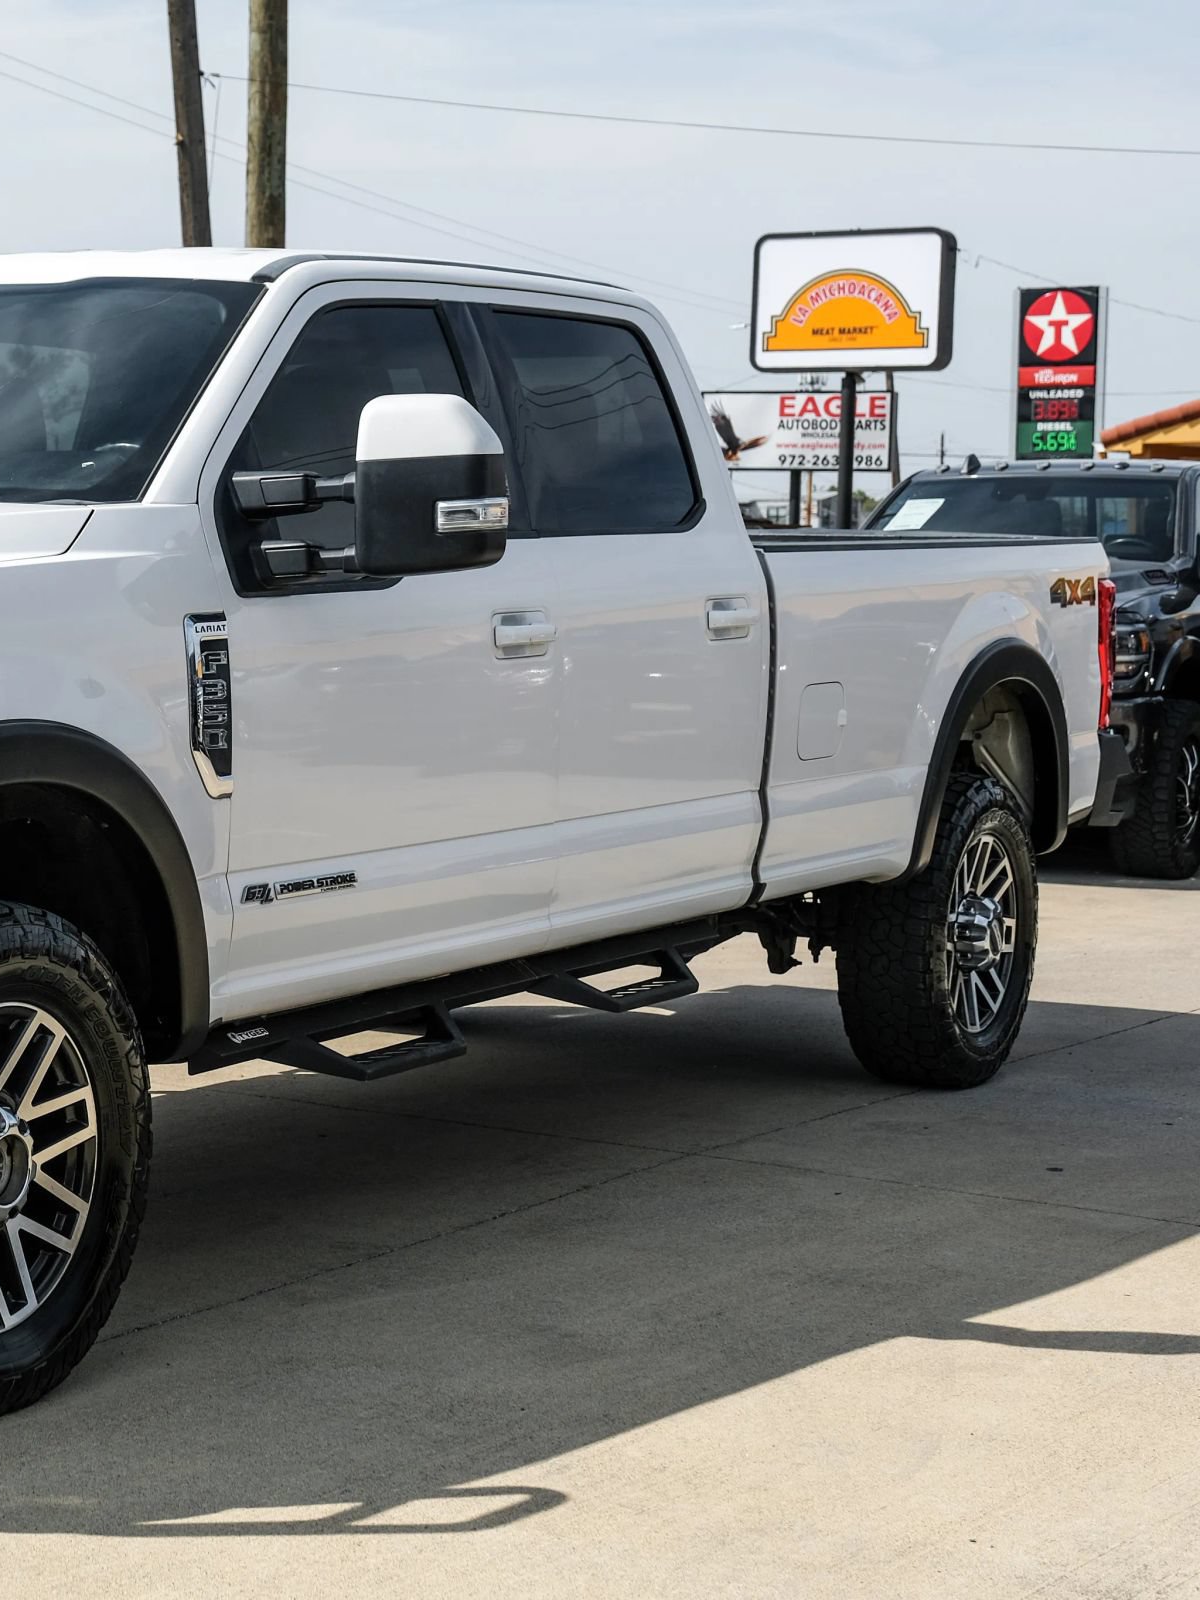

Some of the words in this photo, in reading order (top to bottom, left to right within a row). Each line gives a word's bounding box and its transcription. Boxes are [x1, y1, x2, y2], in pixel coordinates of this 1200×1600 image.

[790, 305, 809, 326] LA
[808, 279, 900, 325] MICHOACANA
[811, 327, 834, 336] MEAT
[838, 326, 875, 336] MARKET
[1028, 388, 1085, 399] UNLEADED
[777, 419, 841, 431] AUTOBOD
[855, 419, 887, 431] ARTS
[1036, 421, 1074, 431] DIESEL
[778, 453, 883, 466] 972-263986
[194, 624, 227, 634] LARIAT
[279, 879, 315, 894] POWER
[316, 872, 357, 887] STROKE
[24, 965, 88, 1005] OPEN
